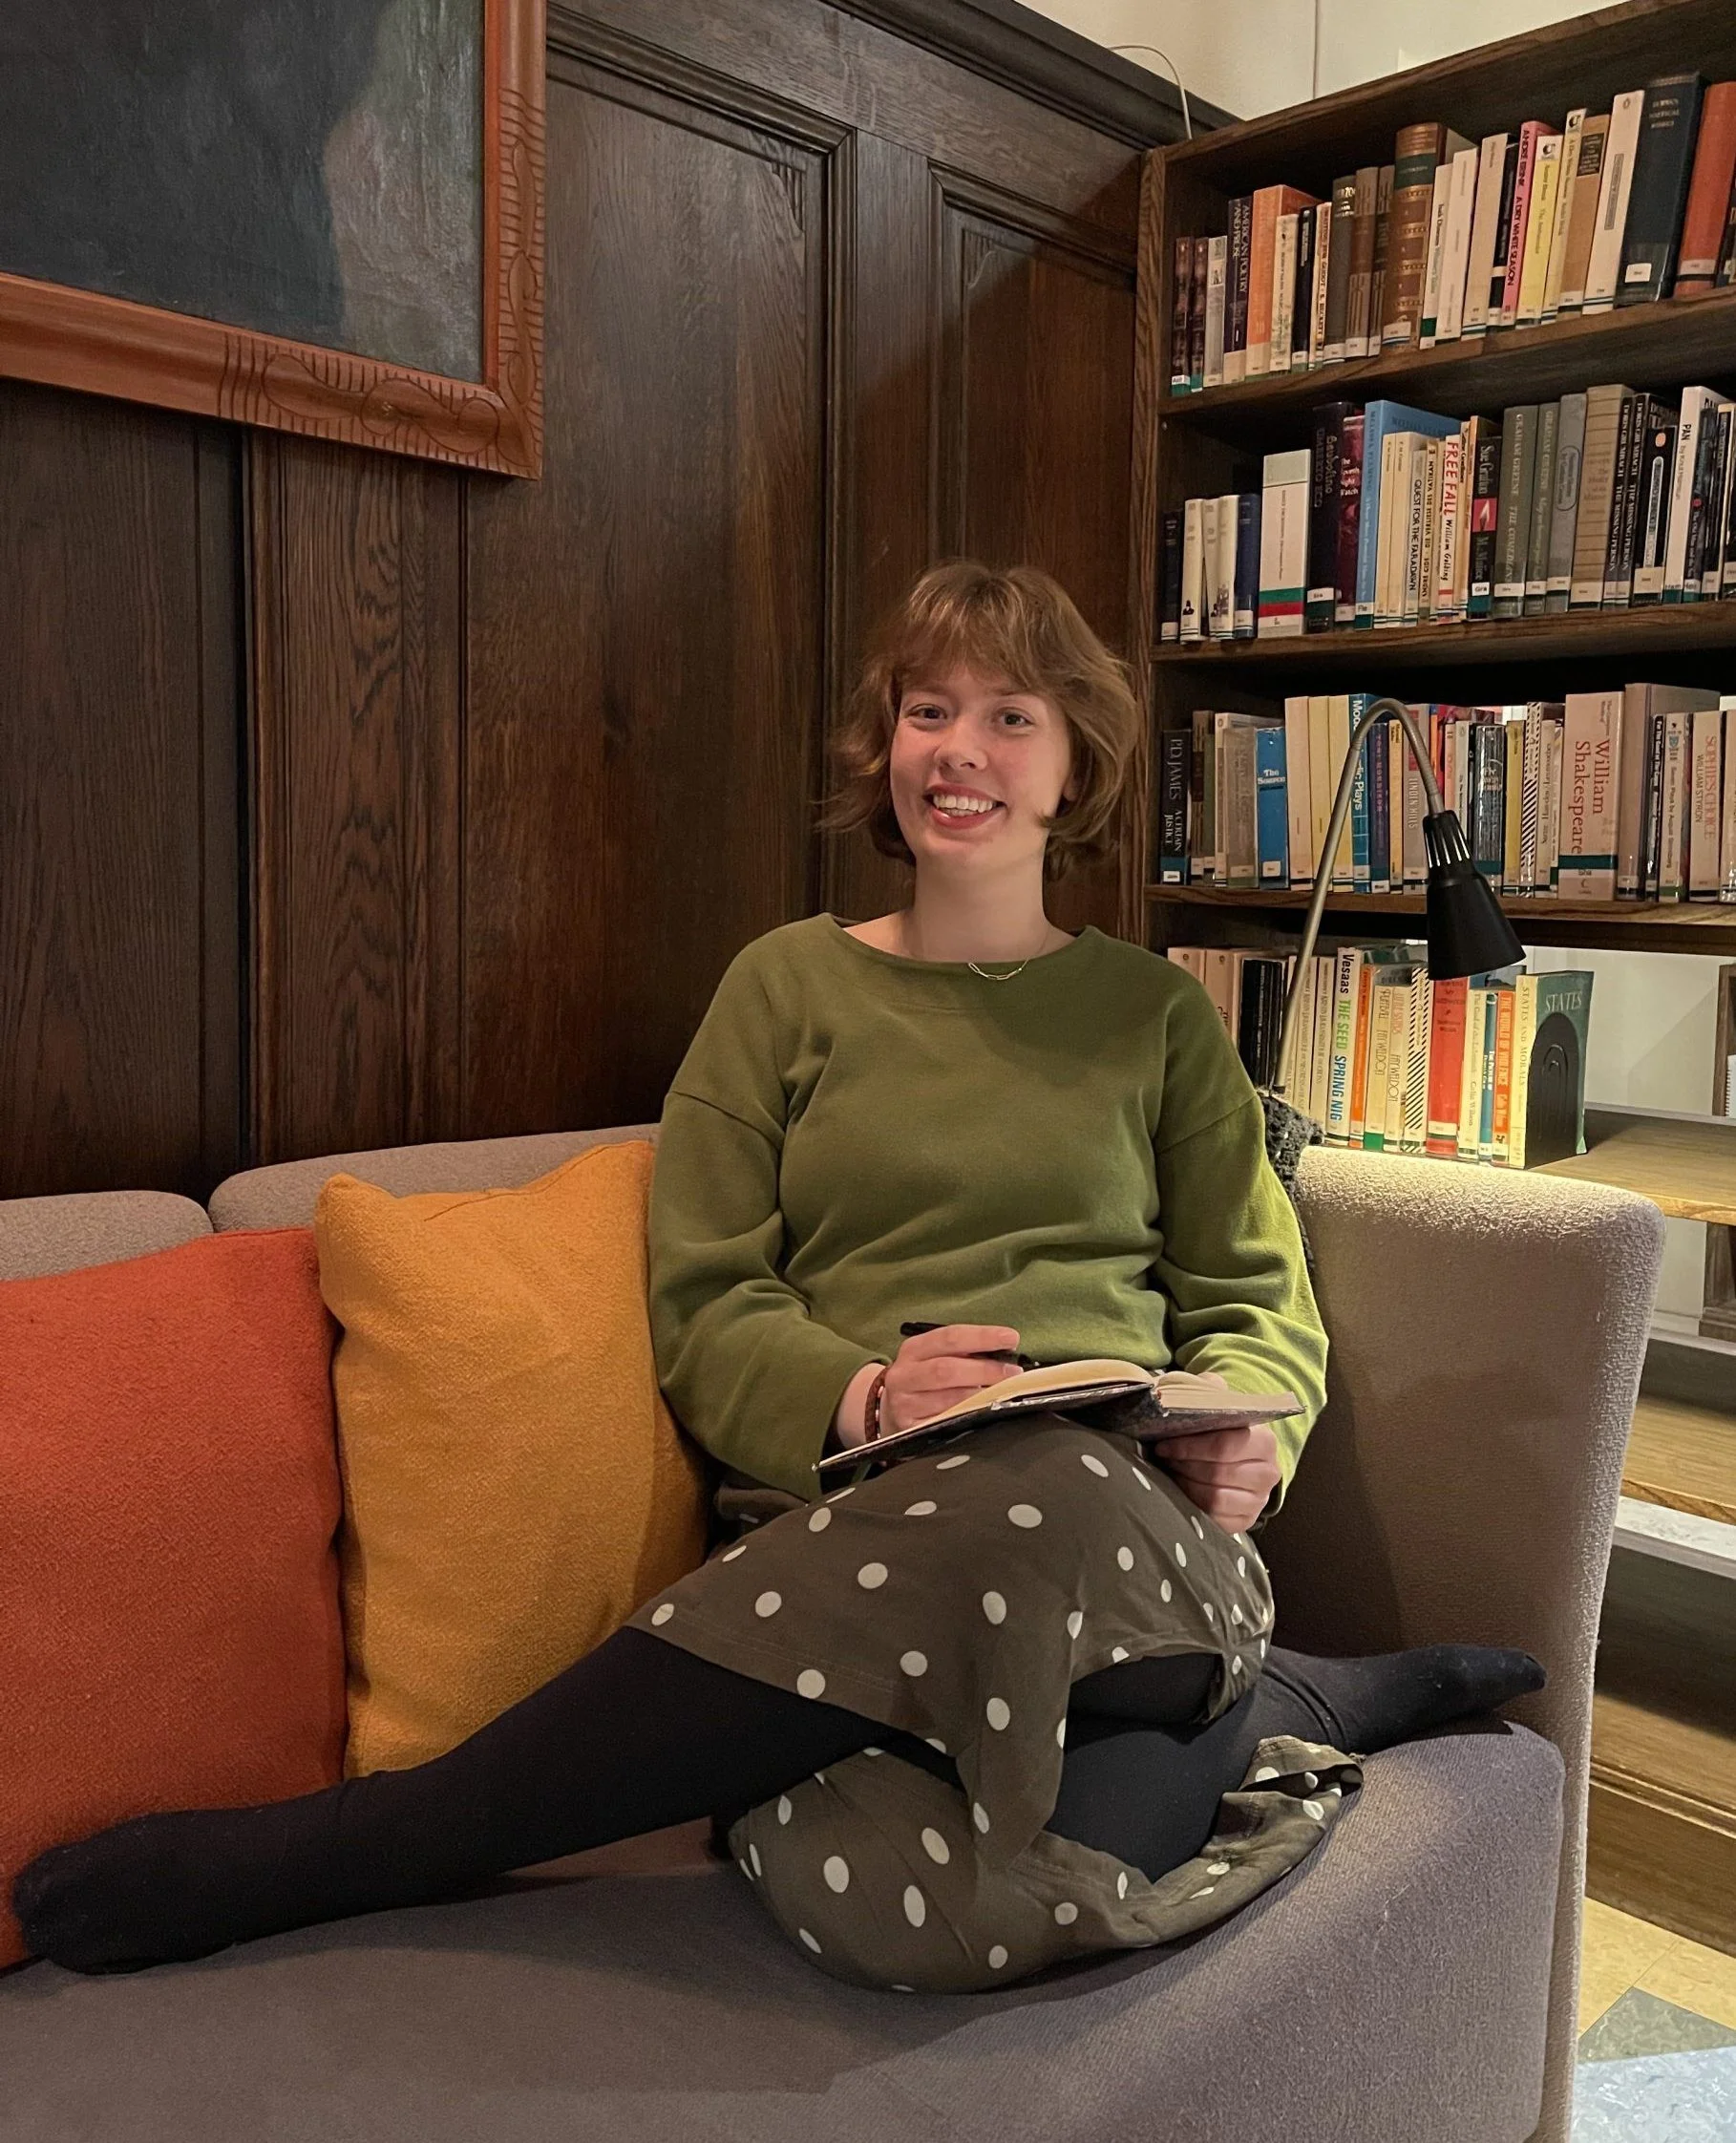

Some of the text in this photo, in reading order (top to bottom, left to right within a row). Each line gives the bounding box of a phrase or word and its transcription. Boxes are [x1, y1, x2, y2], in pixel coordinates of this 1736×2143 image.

[1514, 204, 1522, 222] DRY
[1239, 204, 1250, 292] AMERICAN POETRY
[1512, 223, 1520, 250] WHITE
[1507, 251, 1517, 286] SEASON
[1681, 424, 1692, 440] PAN
[1480, 445, 1494, 462] Sue
[1441, 441, 1459, 582] FREE FALL William Golding
[1408, 479, 1423, 592] QUEST FOR THE FARADAWN
[1167, 761, 1183, 800] JAMES
[1592, 738, 1611, 815] William
[1350, 781, 1365, 811] Plays
[1568, 740, 1591, 855] Shakespeare
[1695, 790, 1704, 823] STYRON
[1164, 815, 1174, 845] JUSTICE
[1704, 793, 1717, 840] CHOICE
[1521, 987, 1530, 1021] STATES
[1545, 993, 1583, 1012] STATES
[1330, 953, 1355, 1121] Vesaas THE SEED SPRING NIG
[1519, 1046, 1528, 1086] MORALS
